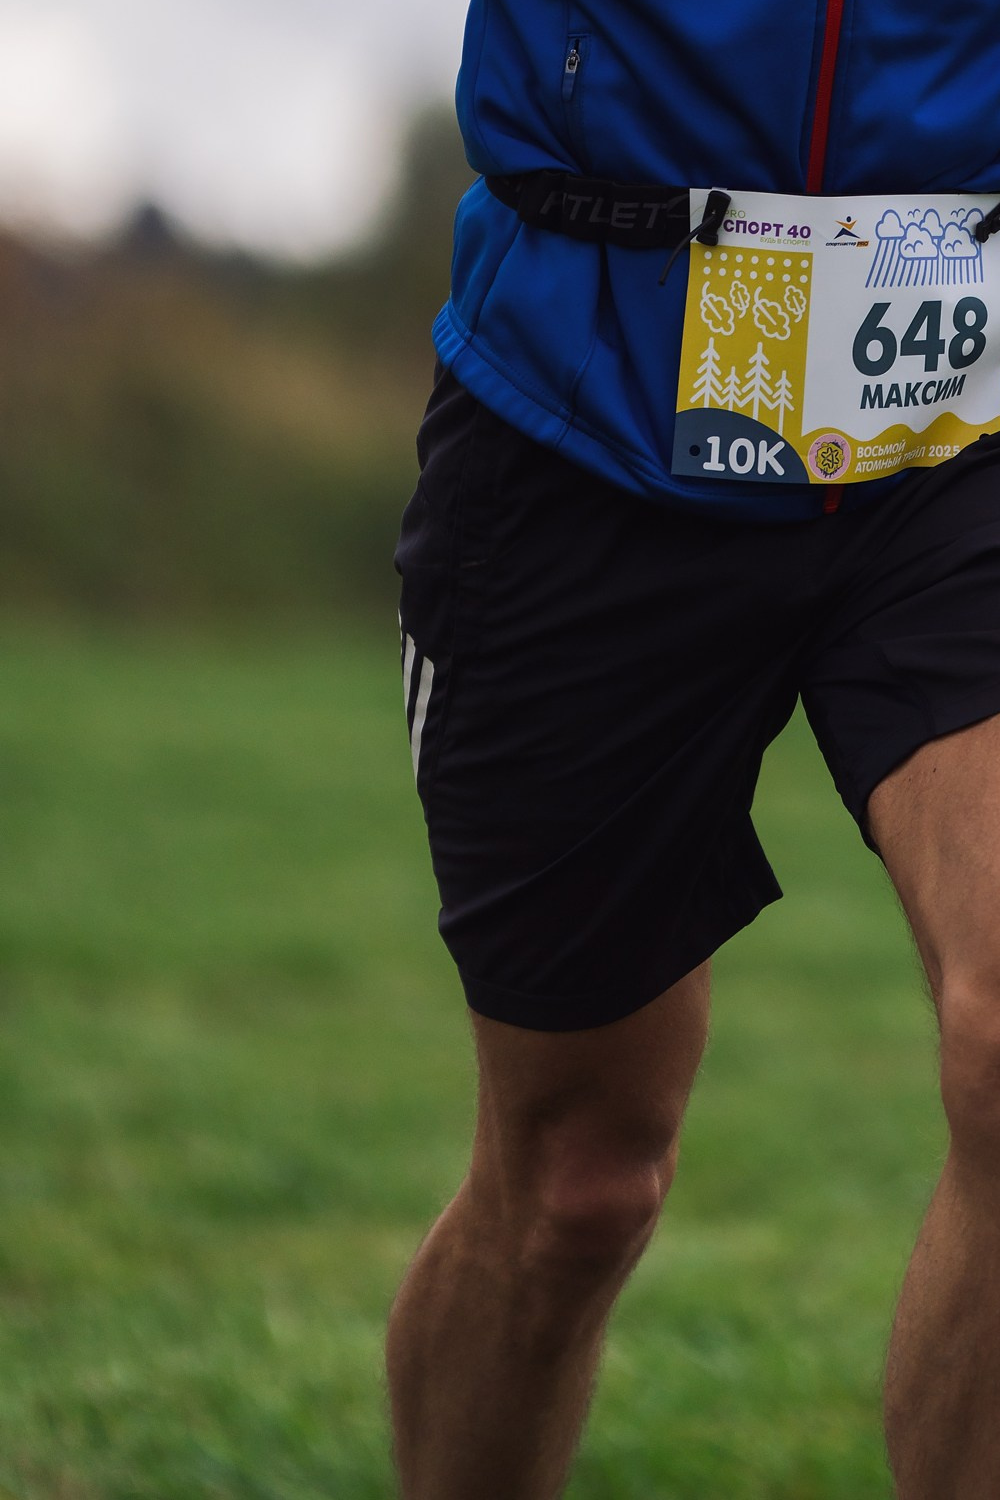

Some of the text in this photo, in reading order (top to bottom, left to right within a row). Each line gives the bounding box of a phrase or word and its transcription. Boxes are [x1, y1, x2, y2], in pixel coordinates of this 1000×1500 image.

[723, 219, 811, 239] СПОРТ 40
[852, 296, 989, 377] 648
[859, 374, 967, 410] МАКСИМ
[702, 435, 786, 477] 10K
[854, 444, 961, 474] АТОМНЫЙ ТРЕЙЛ 2025
[856, 439, 907, 459] ВОСЬМОЙ
